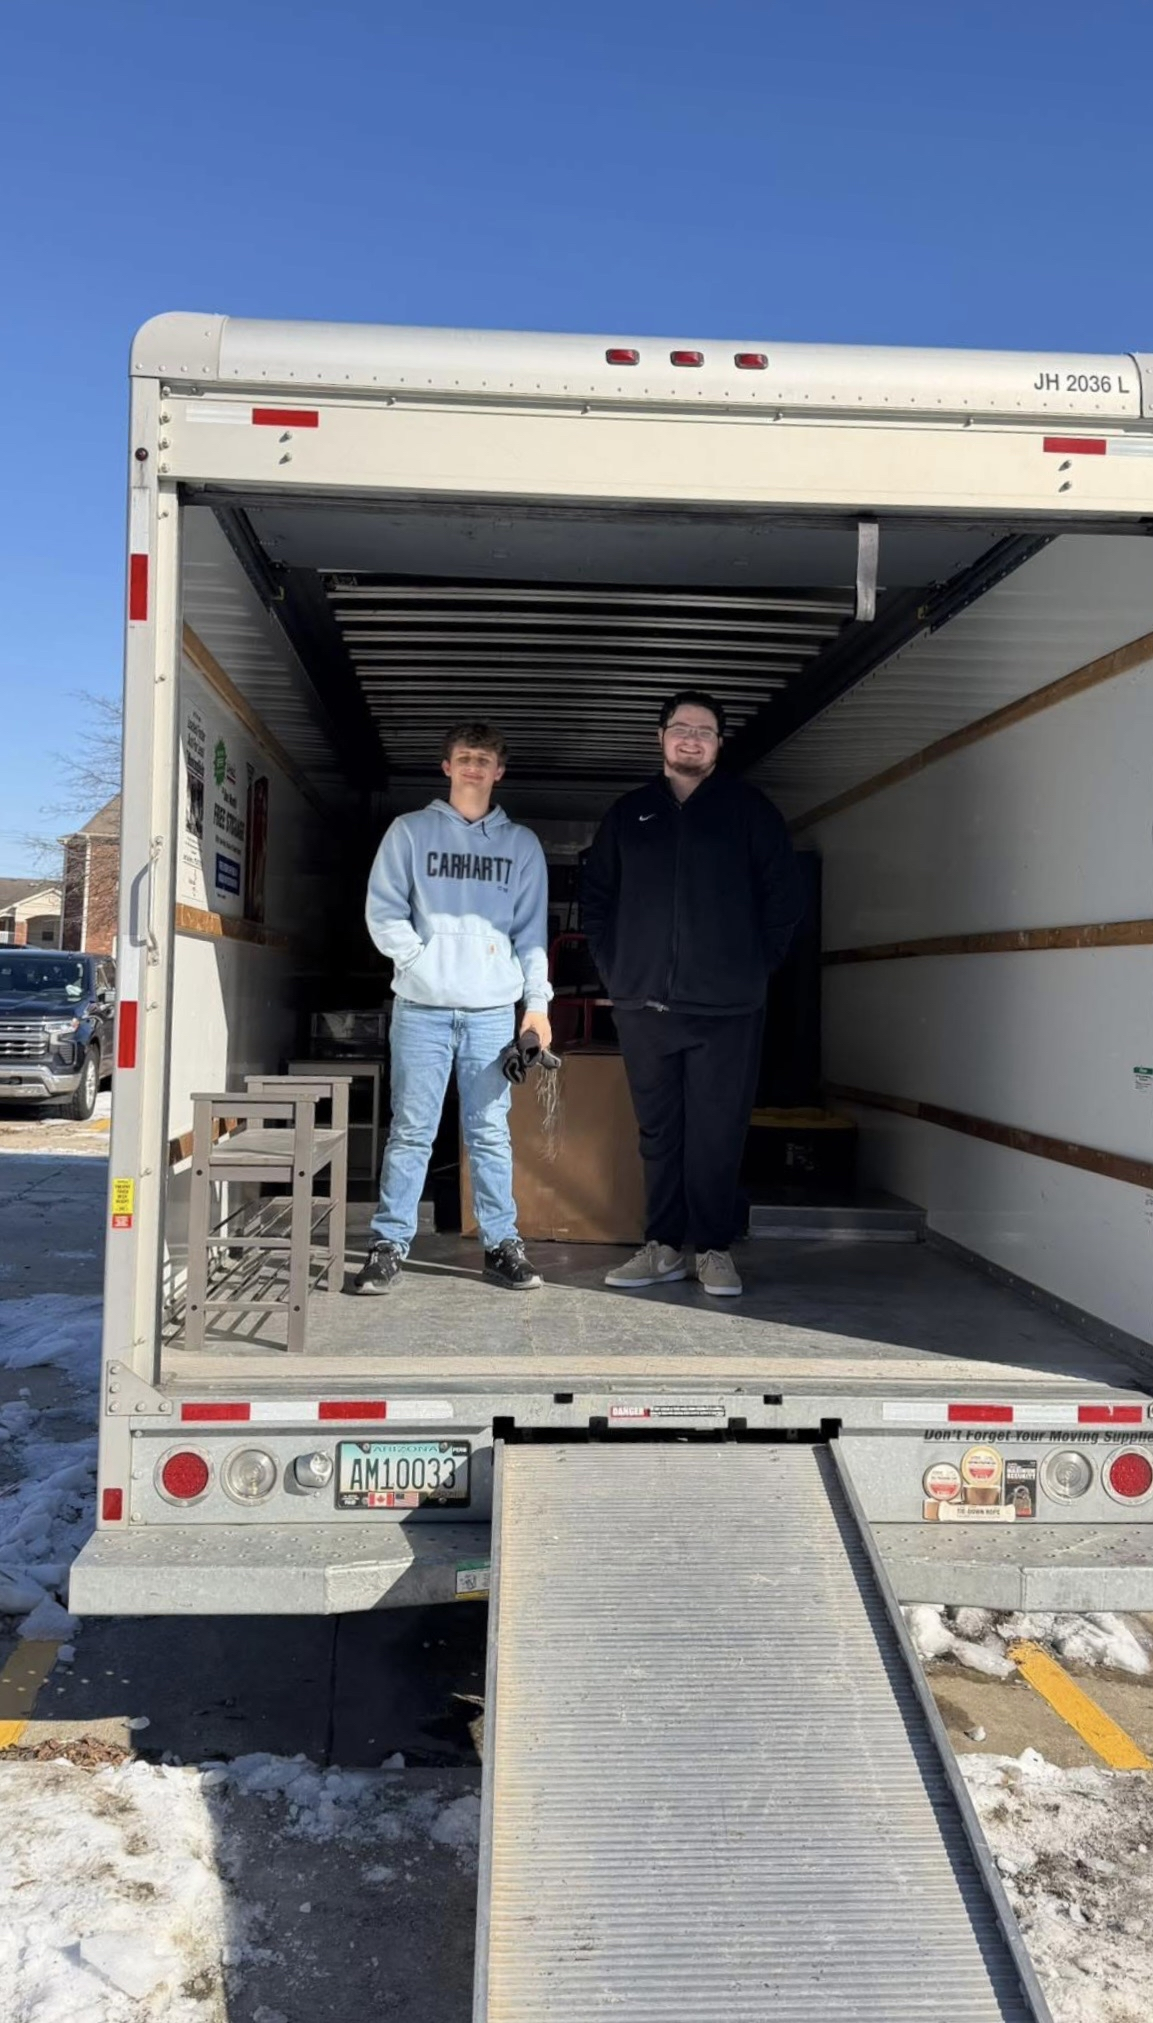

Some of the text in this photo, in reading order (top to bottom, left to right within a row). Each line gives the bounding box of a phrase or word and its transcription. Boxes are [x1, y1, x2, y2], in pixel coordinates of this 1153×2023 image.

[1034, 373, 1130, 394] JH 2036 L
[427, 851, 513, 885] CARHARTT
[612, 1406, 645, 1417] DANGER
[924, 1429, 961, 1441] Don't
[966, 1430, 1012, 1444] Forget
[1016, 1430, 1046, 1441] Your
[1050, 1431, 1100, 1445] Moving
[350, 1458, 455, 1490] AM10033
